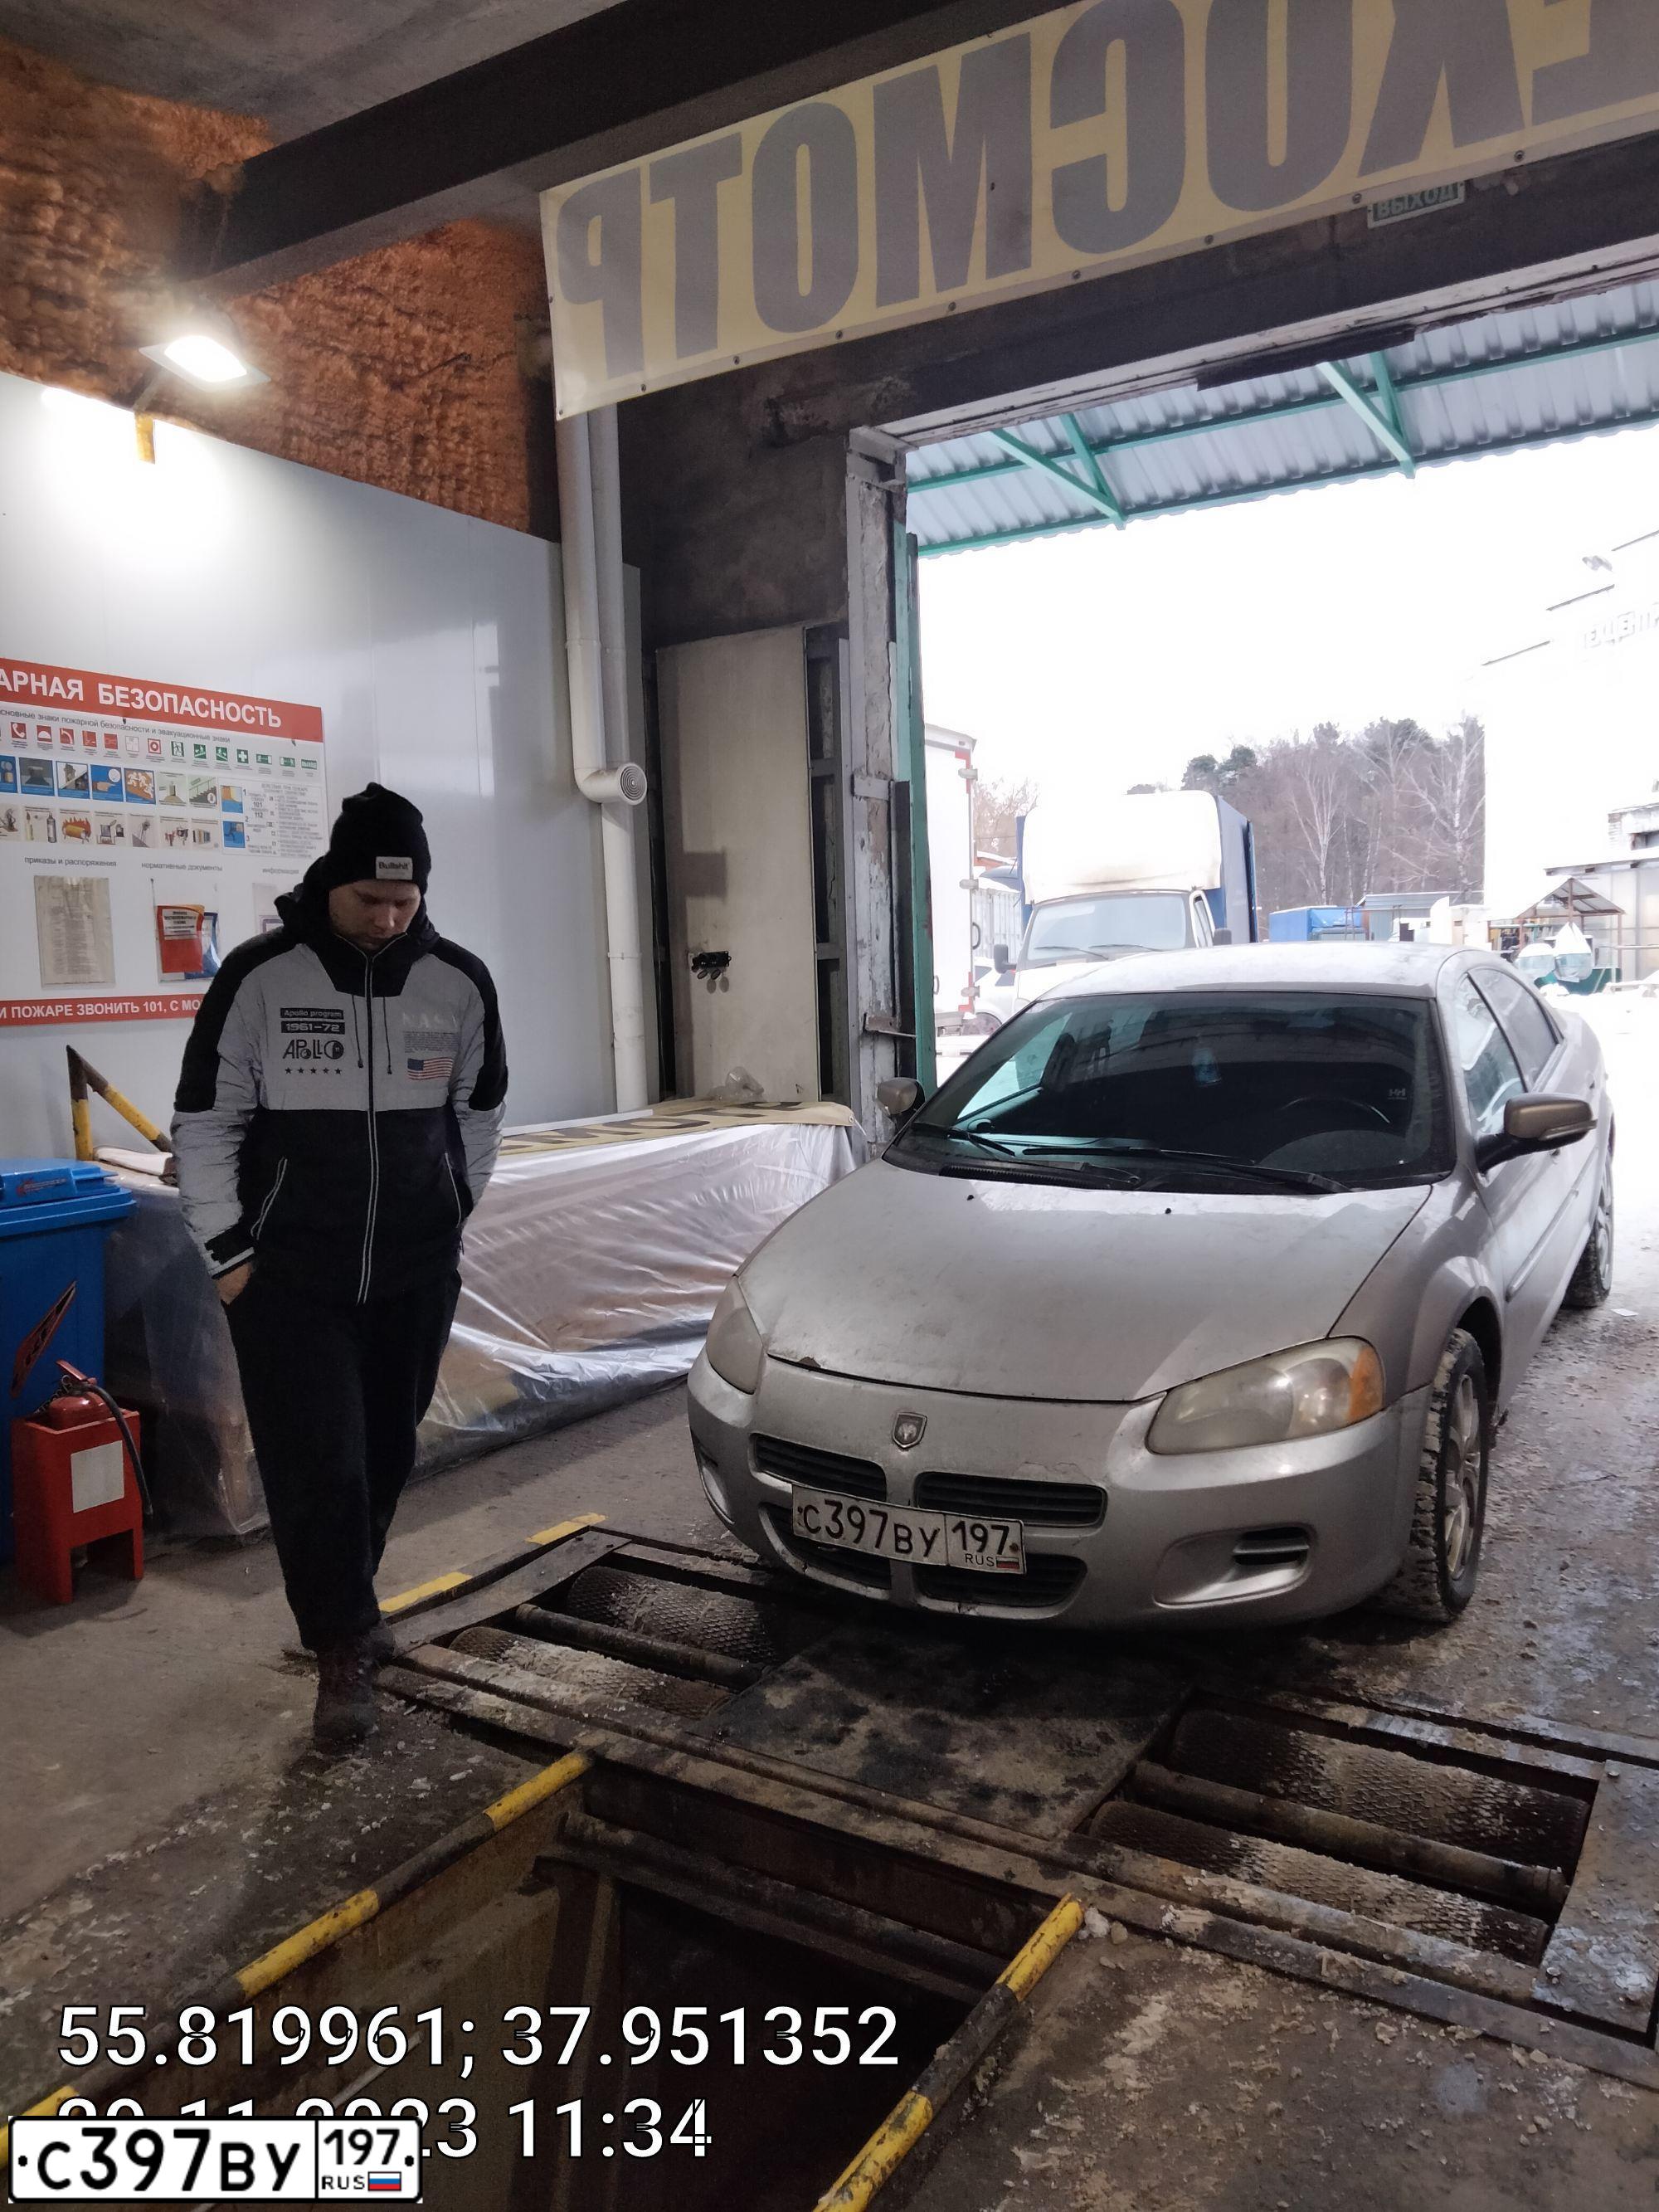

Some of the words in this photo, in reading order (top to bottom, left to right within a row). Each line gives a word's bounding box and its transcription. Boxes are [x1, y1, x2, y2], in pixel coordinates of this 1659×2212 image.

[1377, 184, 1455, 219] ВЫХОД
[0, 668, 84, 701] АРНАЯ
[98, 683, 281, 728] БЕЗОПАСНОСТЬ
[37, 714, 60, 723] знаки
[61, 716, 99, 728] пожарной
[100, 719, 150, 734] безопасности
[158, 728, 211, 742] эвакуационные
[212, 734, 231, 743] знаки
[24, 856, 56, 865] приказы
[65, 858, 117, 867] распоряжения
[141, 862, 187, 870] нормативные
[187, 864, 223, 872] документы
[11, 1004, 73, 1019] ПОЖАРЕ
[76, 1002, 140, 1016] ЗВОНИТЬ
[144, 1001, 167, 1013] 101,
[169, 1000, 179, 1011] С
[182, 999, 203, 1011] МО
[310, 1011, 342, 1019] program
[803, 1499, 941, 1557] С397ВУ
[951, 1520, 1010, 1556] 197
[965, 1552, 995, 1567] RUS
